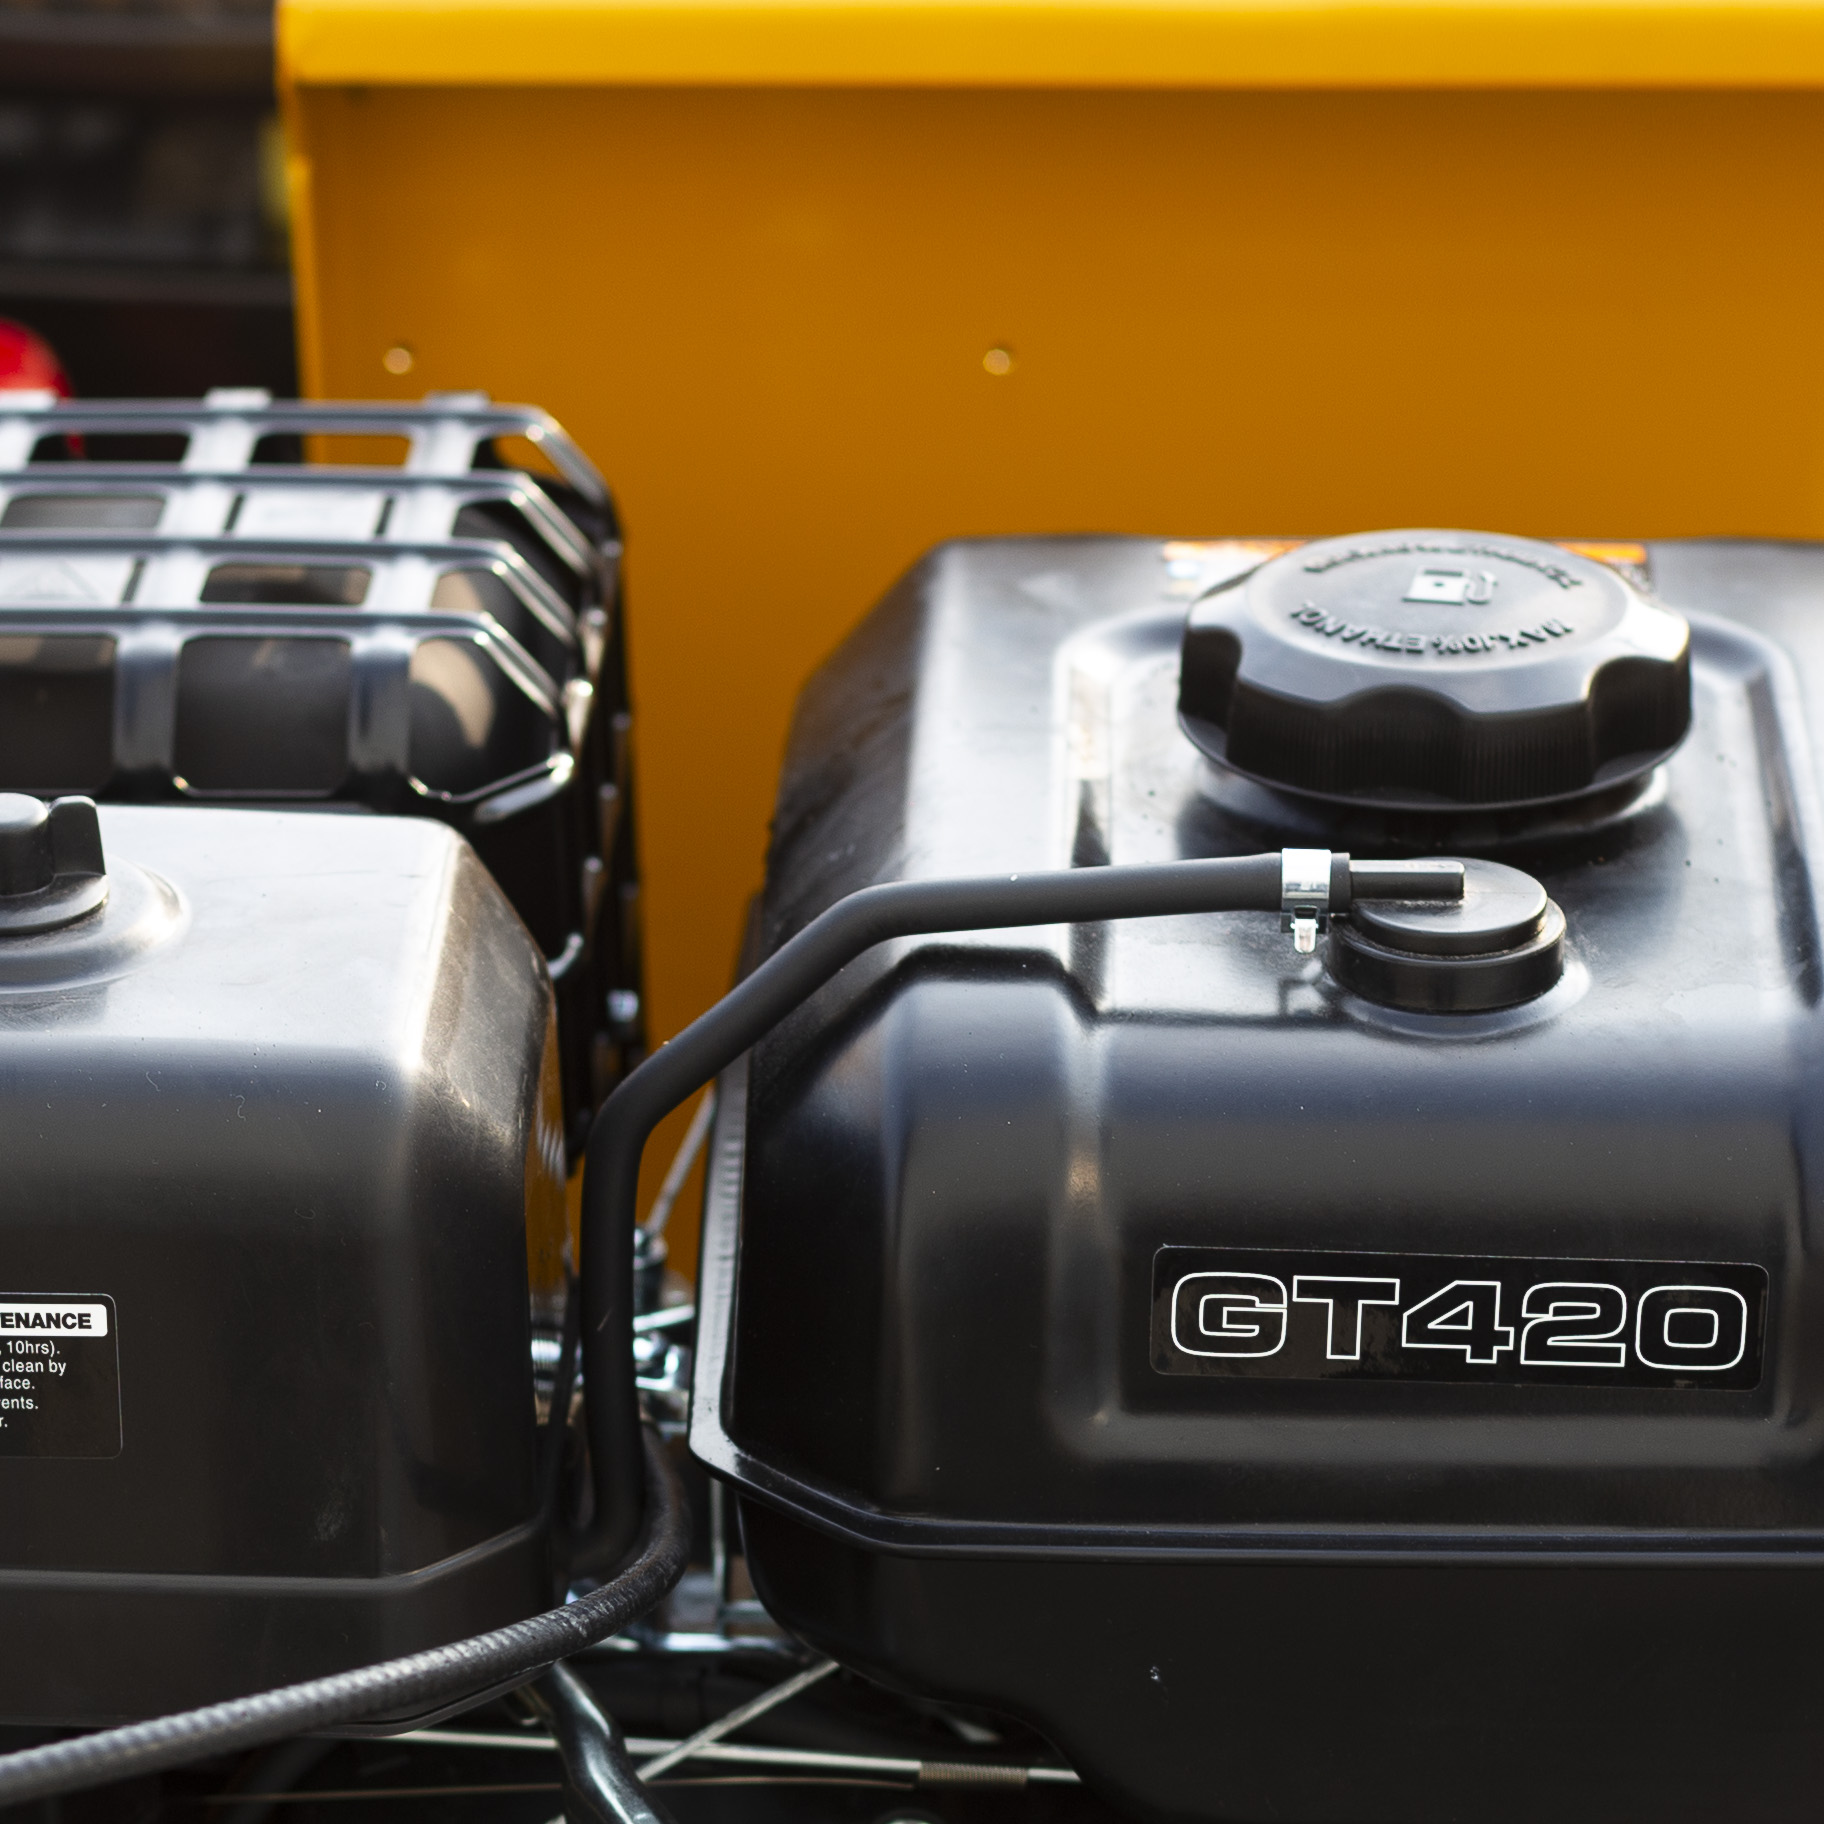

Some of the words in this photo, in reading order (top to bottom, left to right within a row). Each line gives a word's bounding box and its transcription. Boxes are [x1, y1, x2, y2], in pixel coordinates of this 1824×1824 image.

[1172, 1271, 1748, 1370] GT420
[7, 1340, 60, 1357] 10hrs).
[2, 1359, 44, 1372] clean
[49, 1359, 66, 1376] by
